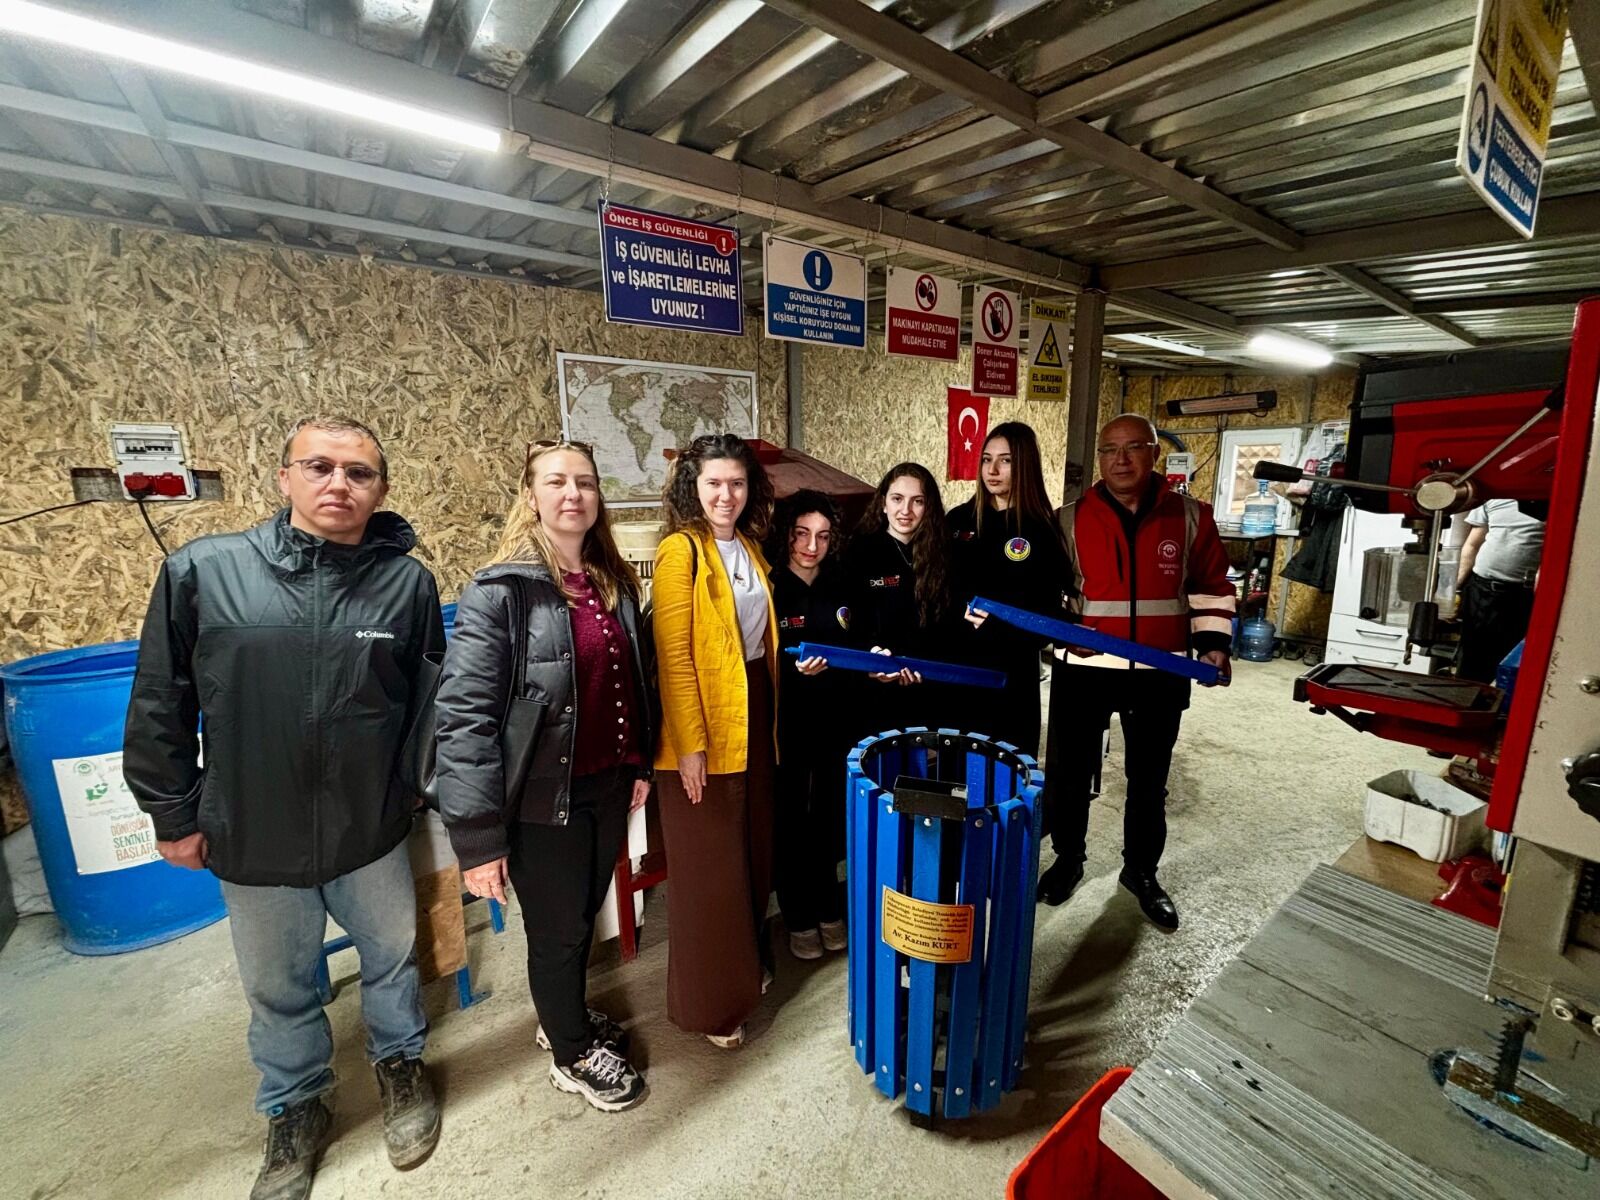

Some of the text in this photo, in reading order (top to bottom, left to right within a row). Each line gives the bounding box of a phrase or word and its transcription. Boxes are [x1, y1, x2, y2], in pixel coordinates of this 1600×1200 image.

[610, 212, 708, 240] ÖNCE İŞ GÜVENLİĞİ
[615, 236, 732, 276] İŞ GÜVENLİĞİ LEVHA
[612, 265, 736, 300] ve İŞARETLEMELERİNE
[651, 298, 699, 318] UYUNUZ
[790, 291, 846, 310] GÜVENLİĞİNİZ İÇİN
[784, 302, 852, 320] YAPTIĞINIZ İŞE UYGUN
[773, 312, 860, 334] KİŞİSEL KORUYUCU DONANIM
[921, 322, 956, 336] KAPATMADAN
[804, 328, 834, 340] KULLANIN
[902, 333, 947, 350] MÜDAHALE ETME
[364, 630, 394, 639] Columbia
[113, 830, 150, 849] SENİNLE
[116, 842, 154, 862] BAŞLAR
[892, 928, 903, 939] Av.
[904, 934, 930, 947] Kazım
[932, 941, 960, 950] KURT
